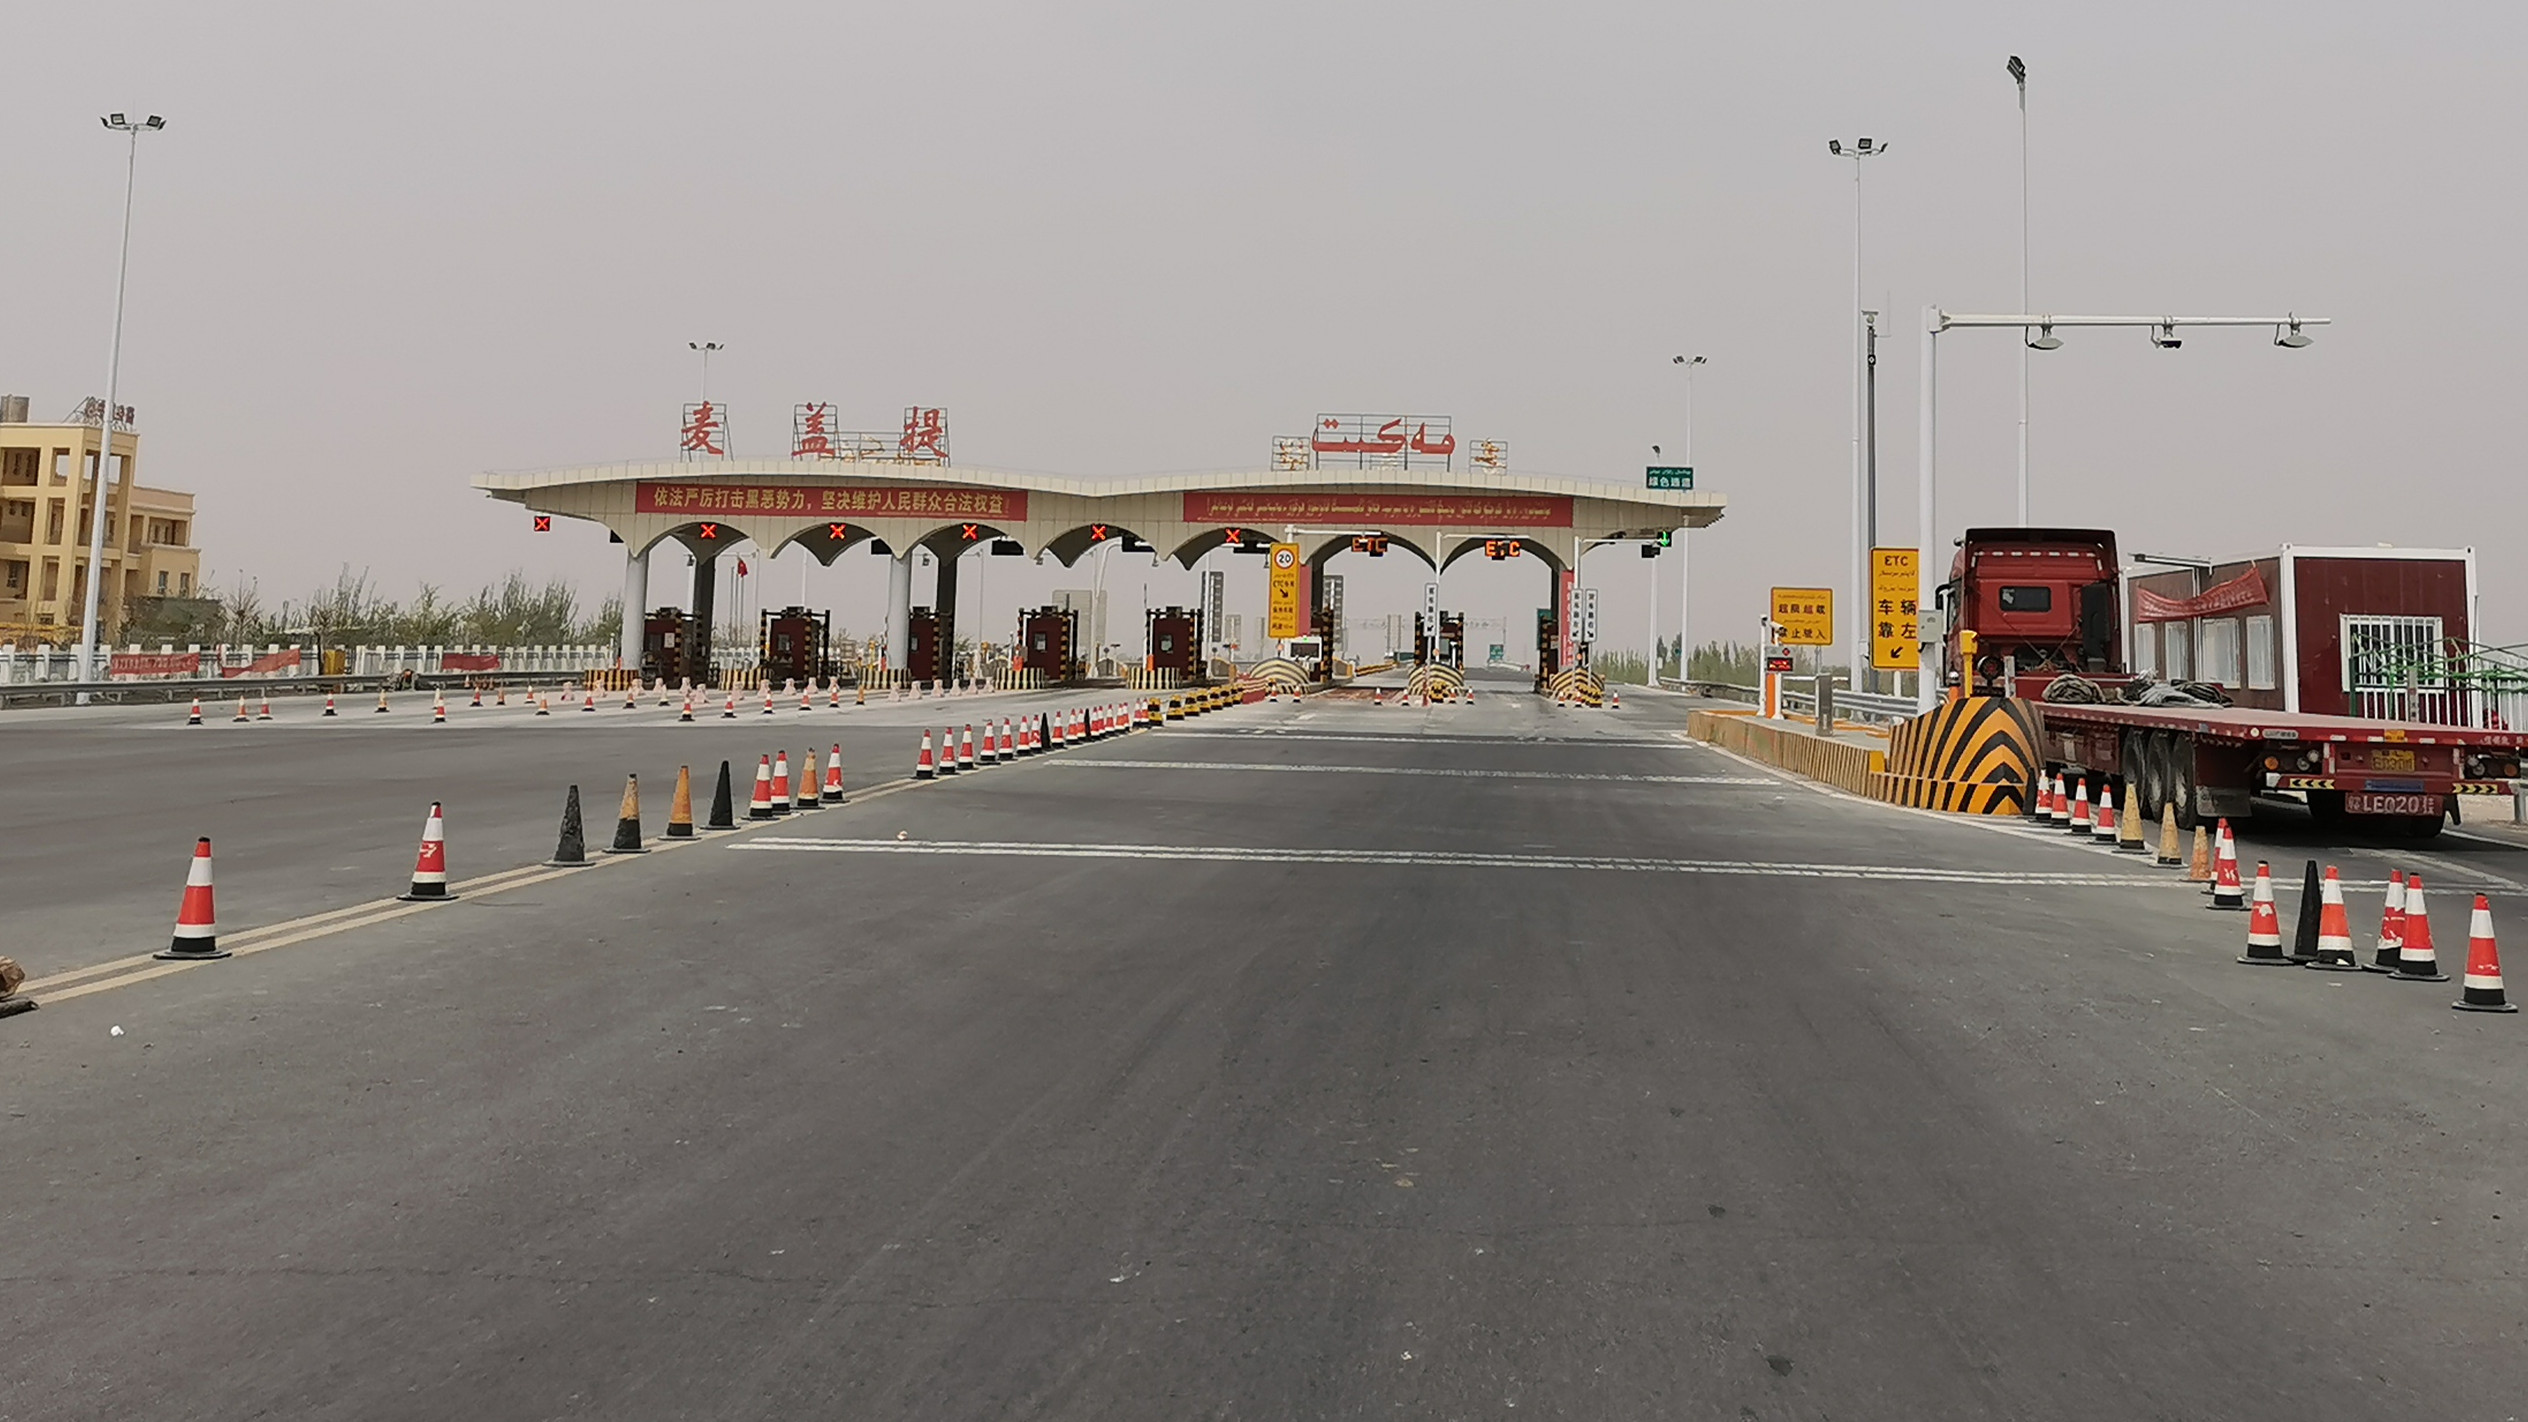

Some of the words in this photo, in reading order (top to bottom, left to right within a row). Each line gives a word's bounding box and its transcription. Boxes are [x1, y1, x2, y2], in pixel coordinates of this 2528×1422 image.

[681, 400, 948, 458] 麦盖提
[1278, 554, 1292, 563] 20
[1884, 555, 1909, 566] ETC
[1878, 599, 1917, 615] 车辆
[1878, 621, 1917, 639] 靠左
